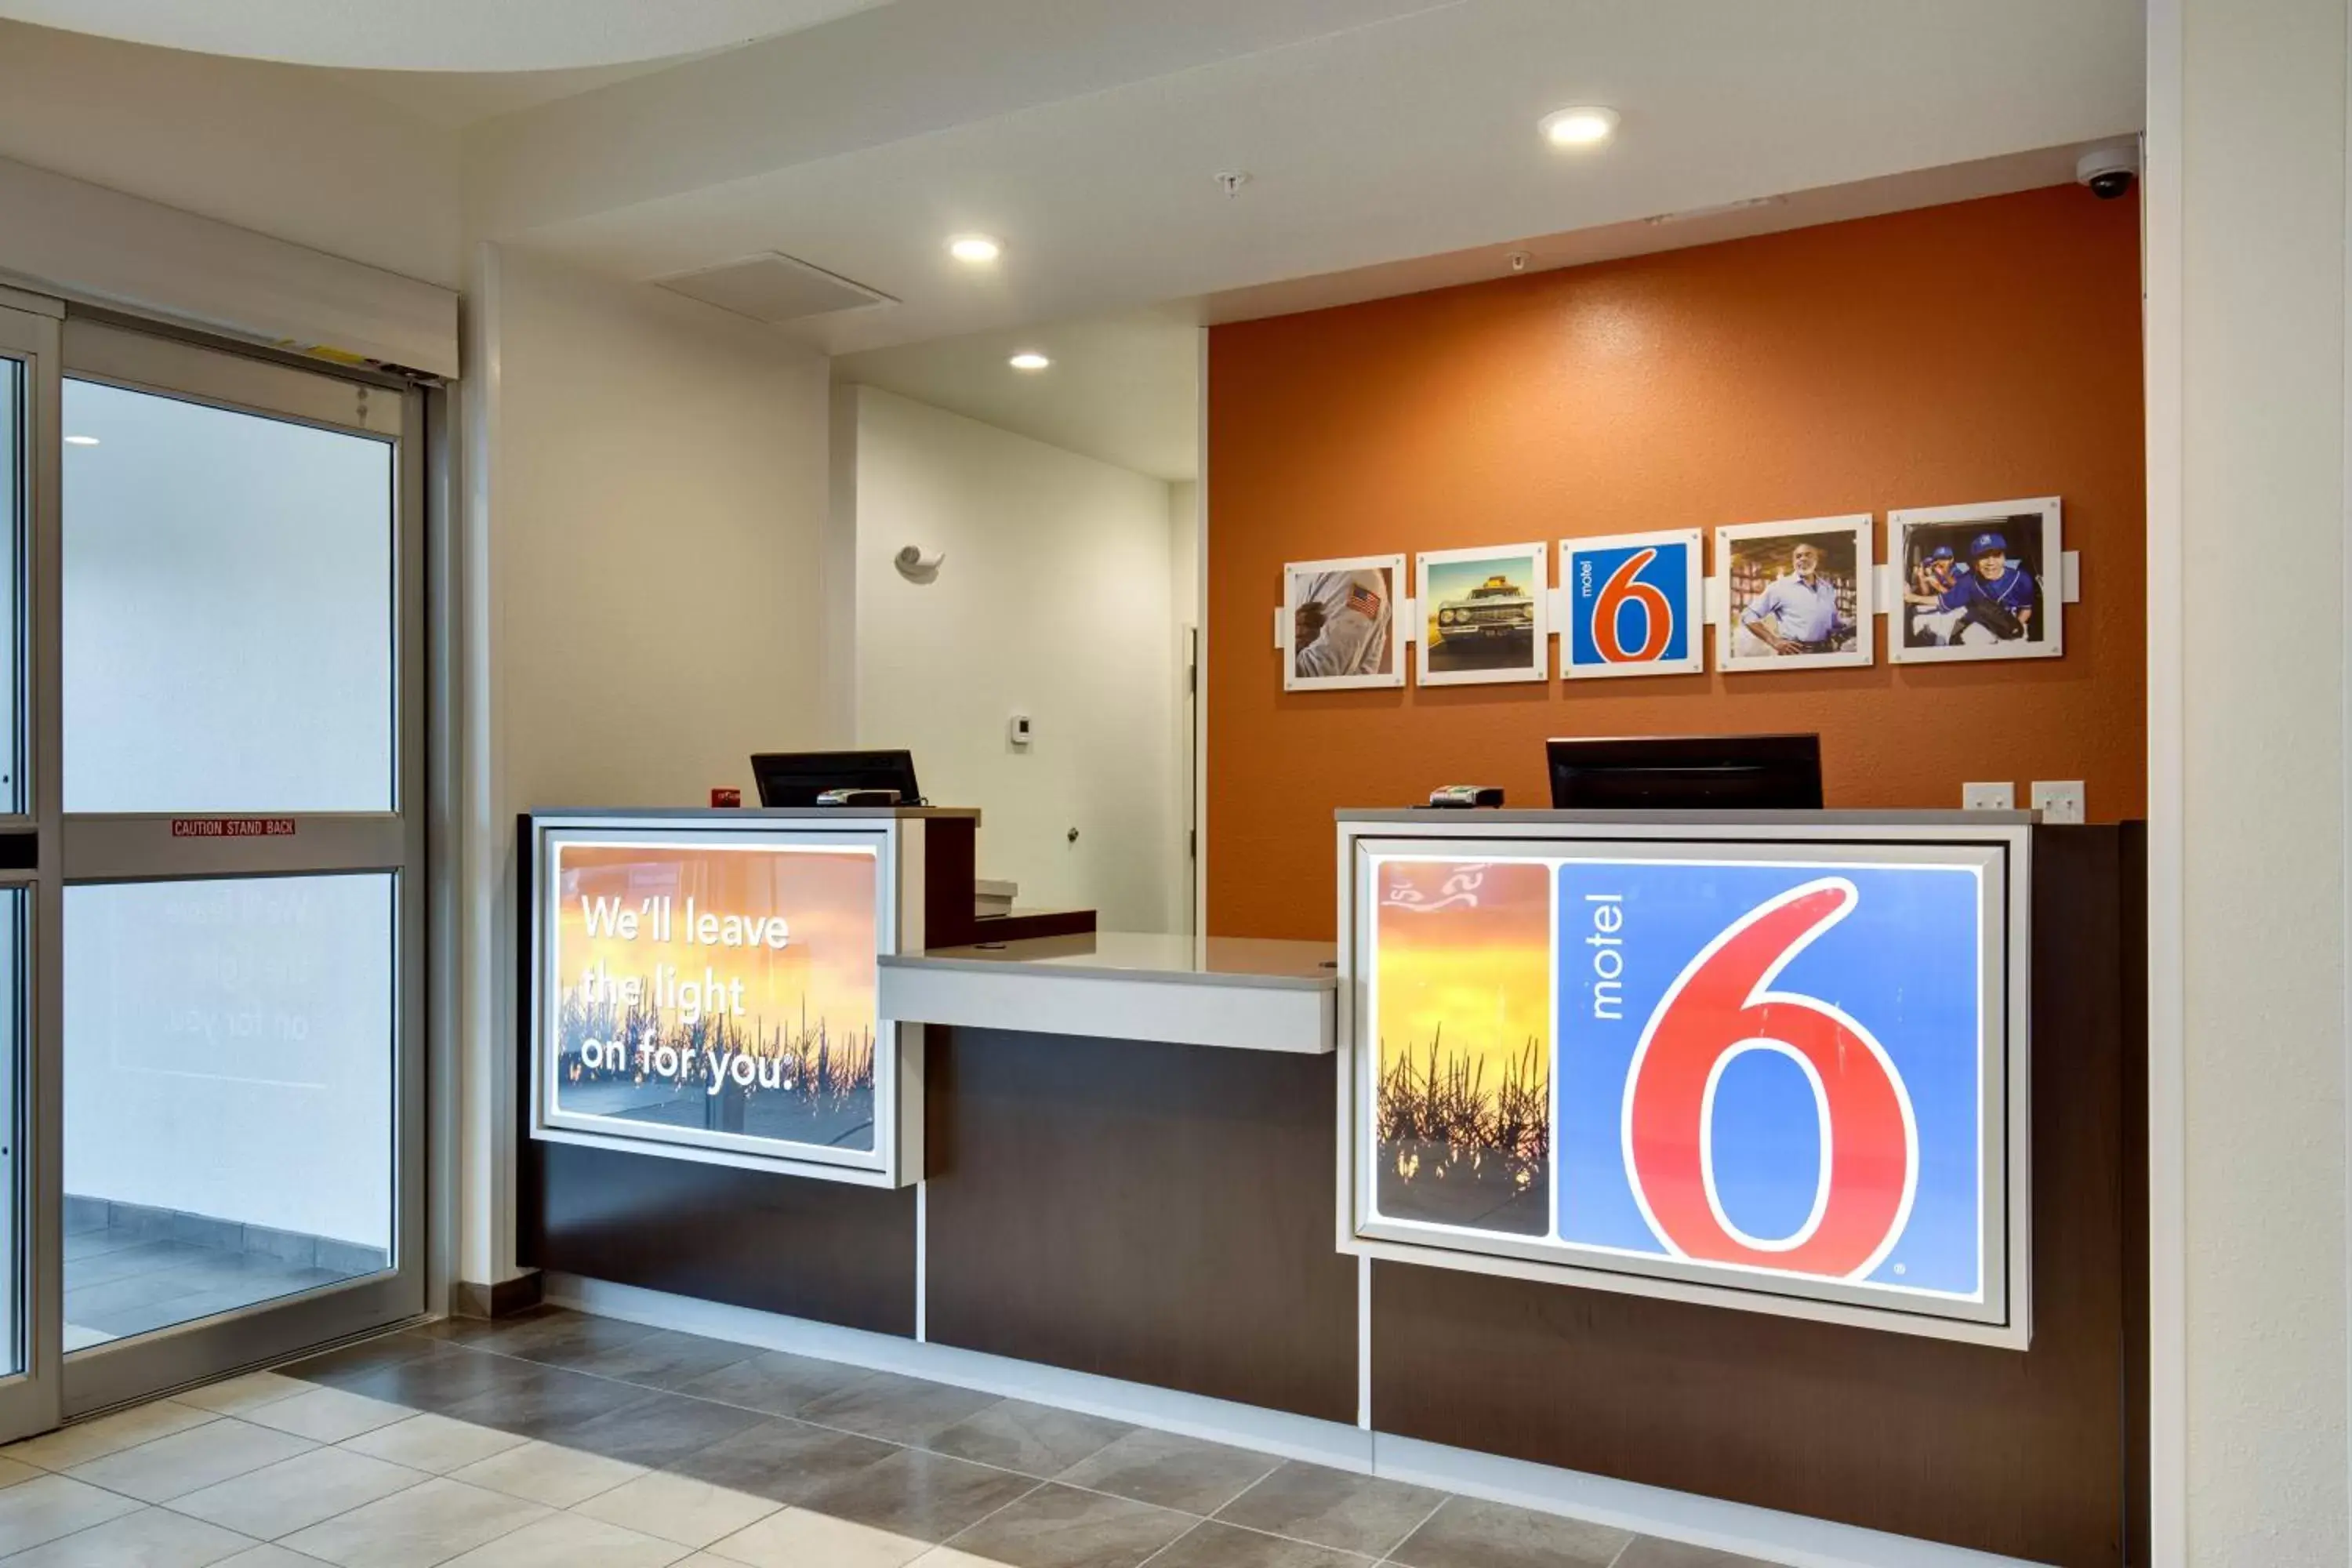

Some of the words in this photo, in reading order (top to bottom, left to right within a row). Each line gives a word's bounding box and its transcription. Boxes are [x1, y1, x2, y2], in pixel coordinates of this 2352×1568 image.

[1580, 561, 1592, 597] motel
[1592, 548, 1673, 662] 6
[175, 821, 222, 835] CAUTION
[227, 821, 262, 834] STAND
[267, 821, 293, 833] BACK
[581, 895, 671, 941] We'll
[686, 896, 789, 949] leave
[581, 959, 641, 1006] the
[655, 963, 746, 1024] light
[581, 1037, 626, 1072] on
[640, 1028, 696, 1078] for
[1585, 895, 1623, 1019] motel
[1621, 877, 1919, 1280] 6
